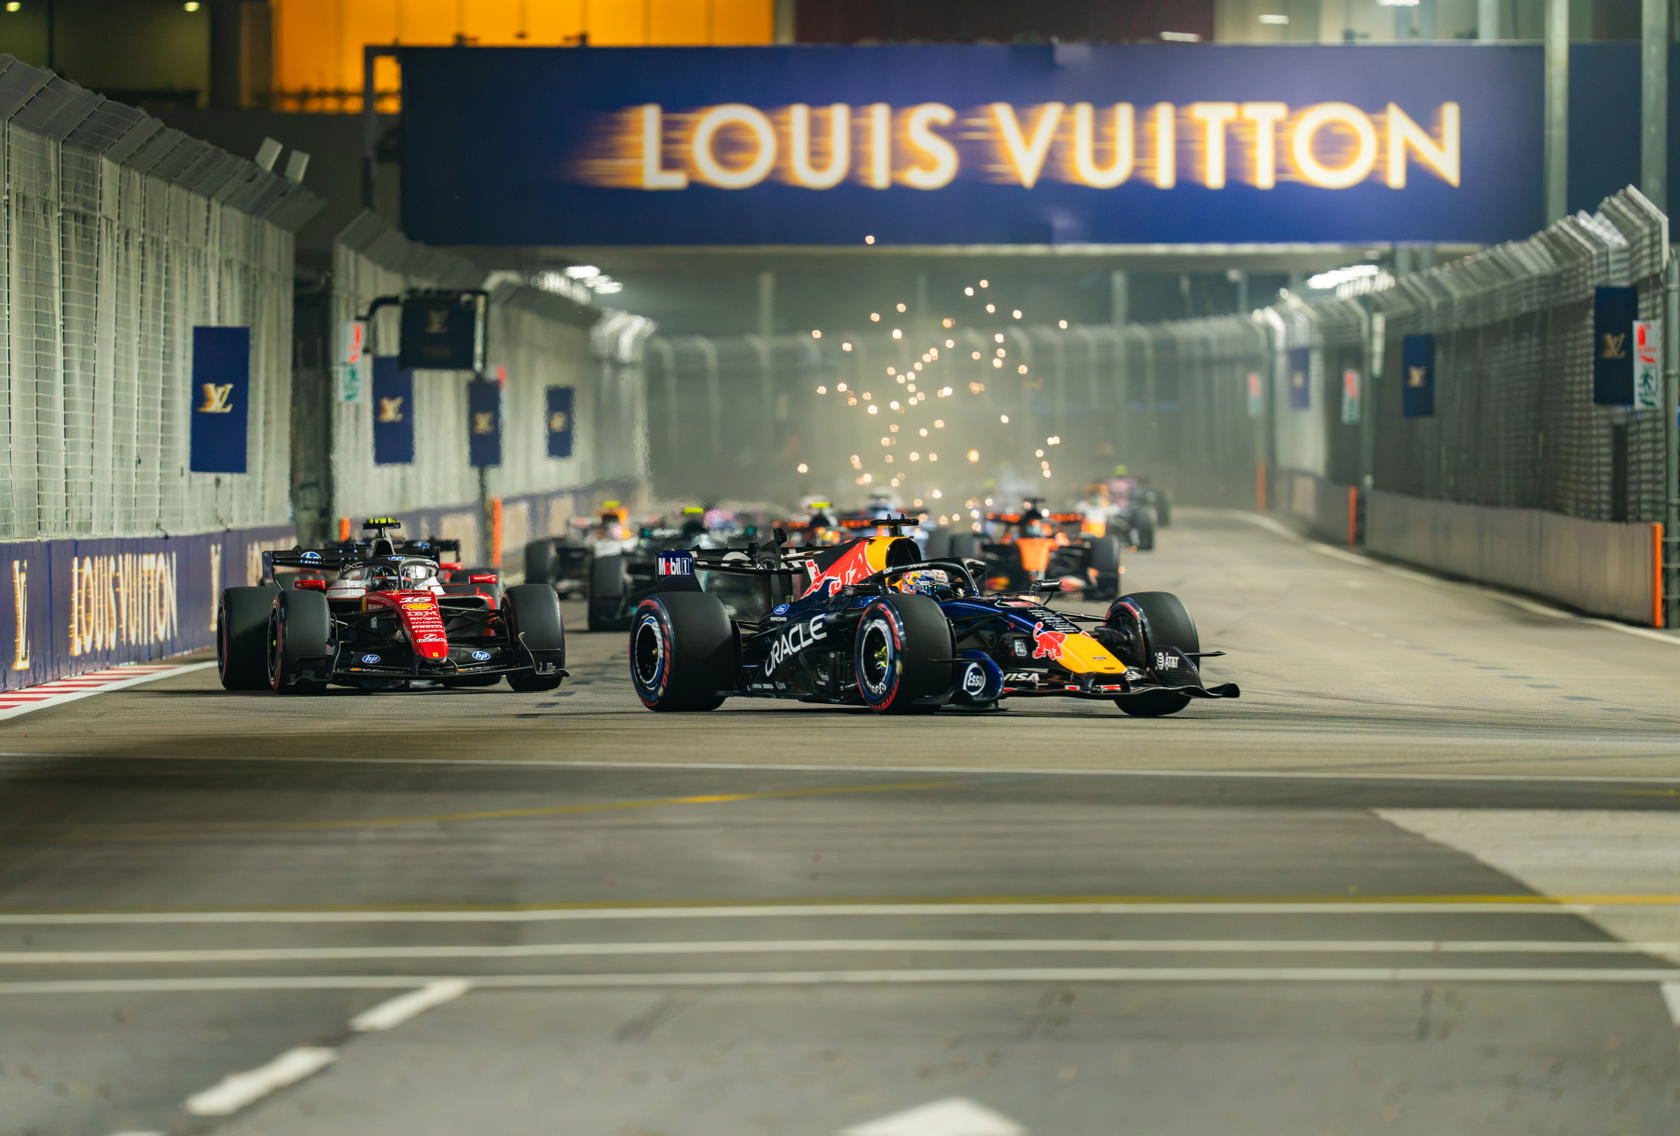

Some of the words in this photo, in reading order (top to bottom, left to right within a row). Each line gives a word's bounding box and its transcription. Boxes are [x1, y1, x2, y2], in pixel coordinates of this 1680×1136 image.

[639, 102, 959, 190] LOUIS
[991, 101, 1462, 191] VUITTON
[69, 555, 117, 657] LOUIS
[117, 551, 178, 646] VUITTON
[658, 557, 681, 576] Mobil
[764, 613, 828, 677] ORACLE
